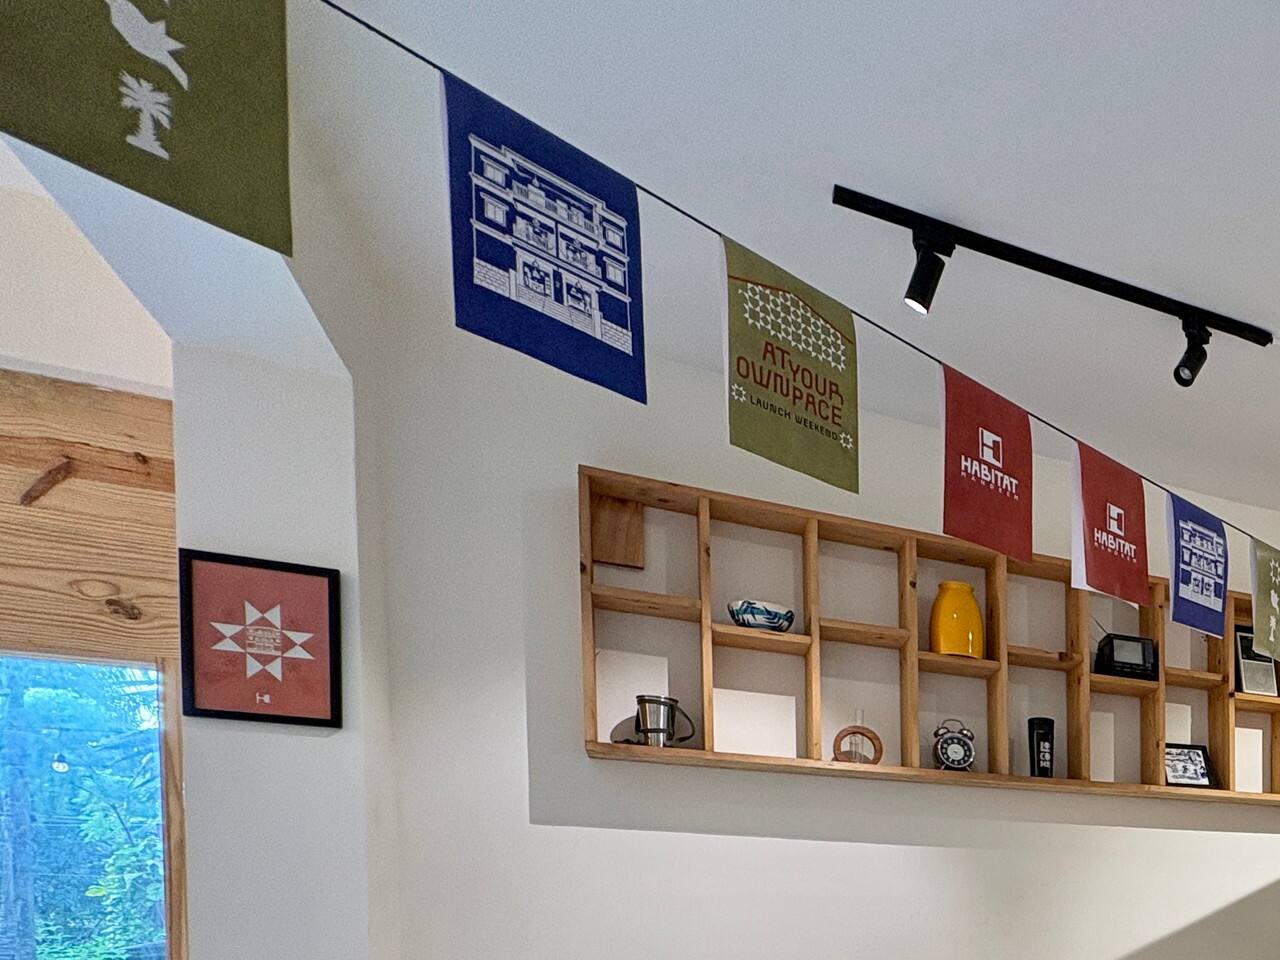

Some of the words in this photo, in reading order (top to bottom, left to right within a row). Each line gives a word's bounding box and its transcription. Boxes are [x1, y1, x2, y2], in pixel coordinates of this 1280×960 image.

[736, 356, 789, 398] OWN
[792, 385, 842, 428] PACE
[762, 341, 790, 370] AT
[788, 359, 844, 406] YOUR
[750, 395, 791, 419] LAUNCH
[795, 414, 838, 441] WEEKEND
[961, 454, 1019, 494] HABITAT
[1094, 527, 1137, 558] HABITAT
